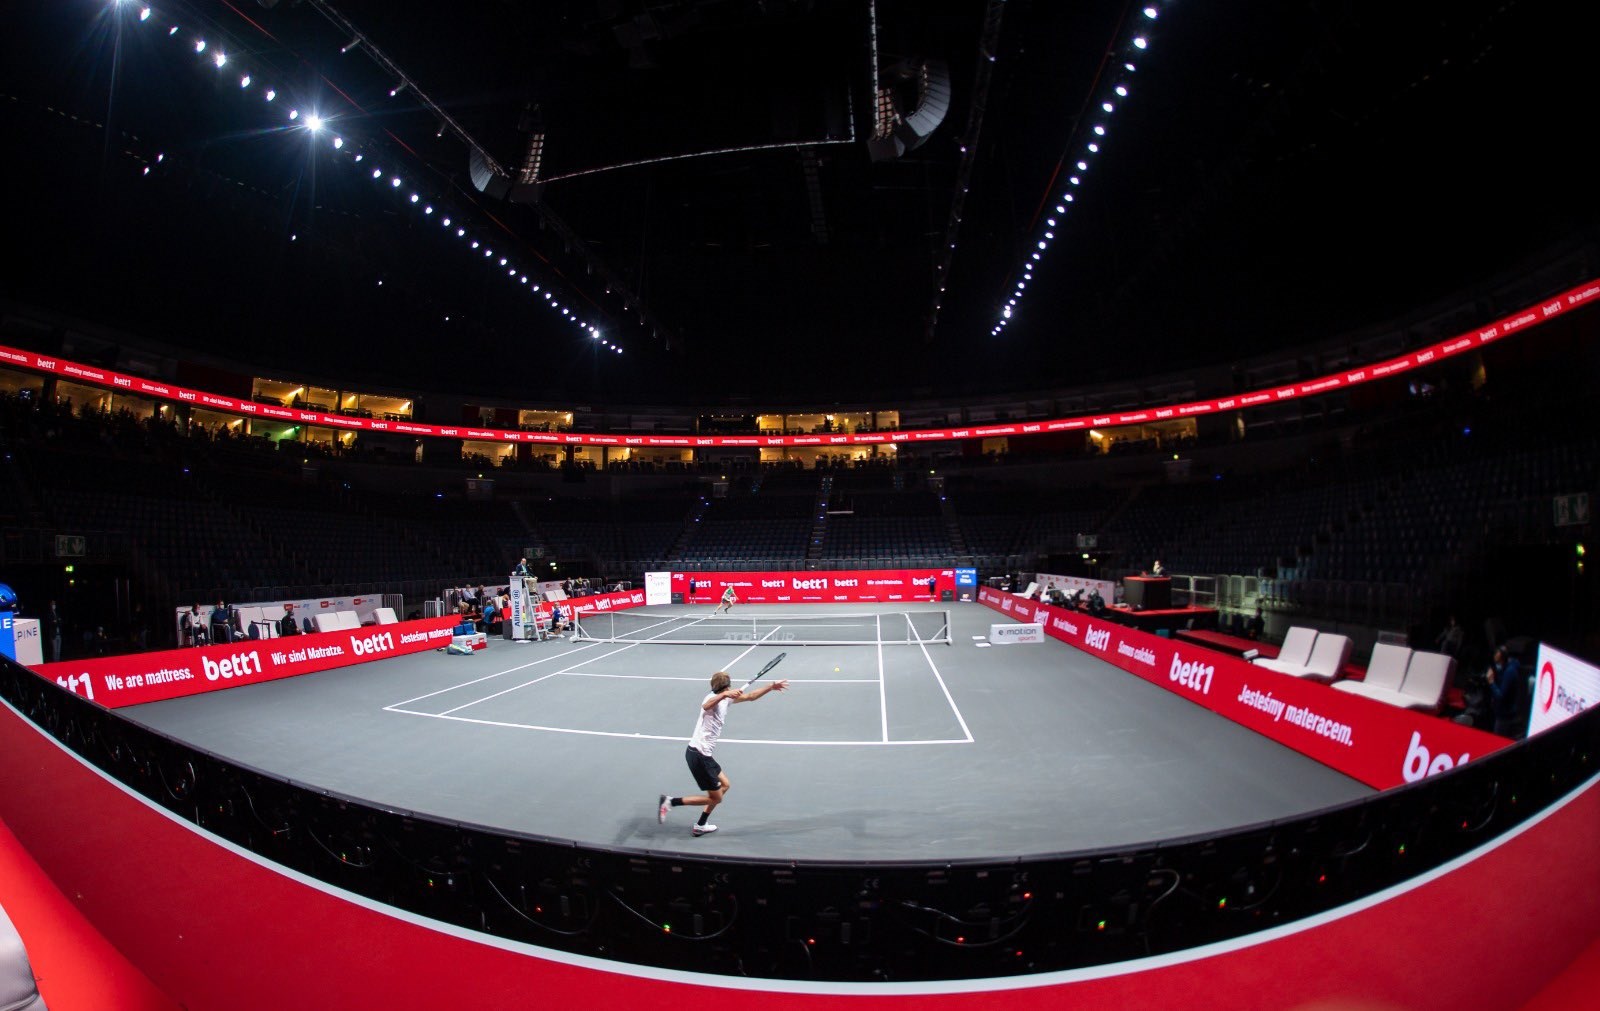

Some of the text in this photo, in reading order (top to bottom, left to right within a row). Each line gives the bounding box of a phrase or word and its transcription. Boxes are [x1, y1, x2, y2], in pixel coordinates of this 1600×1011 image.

[37, 358, 55, 369] bett1
[114, 376, 131, 386] bett1
[179, 391, 195, 400] bett1
[241, 403, 256, 412] bett1
[793, 578, 827, 589] bett1
[594, 598, 612, 612] bett1
[513, 601, 521, 627] Allianz
[17, 627, 38, 641] PINE
[400, 631, 429, 644] Jesteśmy
[1085, 624, 1110, 651] bett1
[351, 632, 394, 656] bett1
[1118, 641, 1136, 658] Somos
[271, 646, 344, 665] Wir sind Matratze.
[202, 651, 261, 680] bett1
[1168, 652, 1214, 695] bett1
[105, 668, 194, 690] We are mattress.
[1238, 685, 1352, 746] Jesteśmy materacem.
